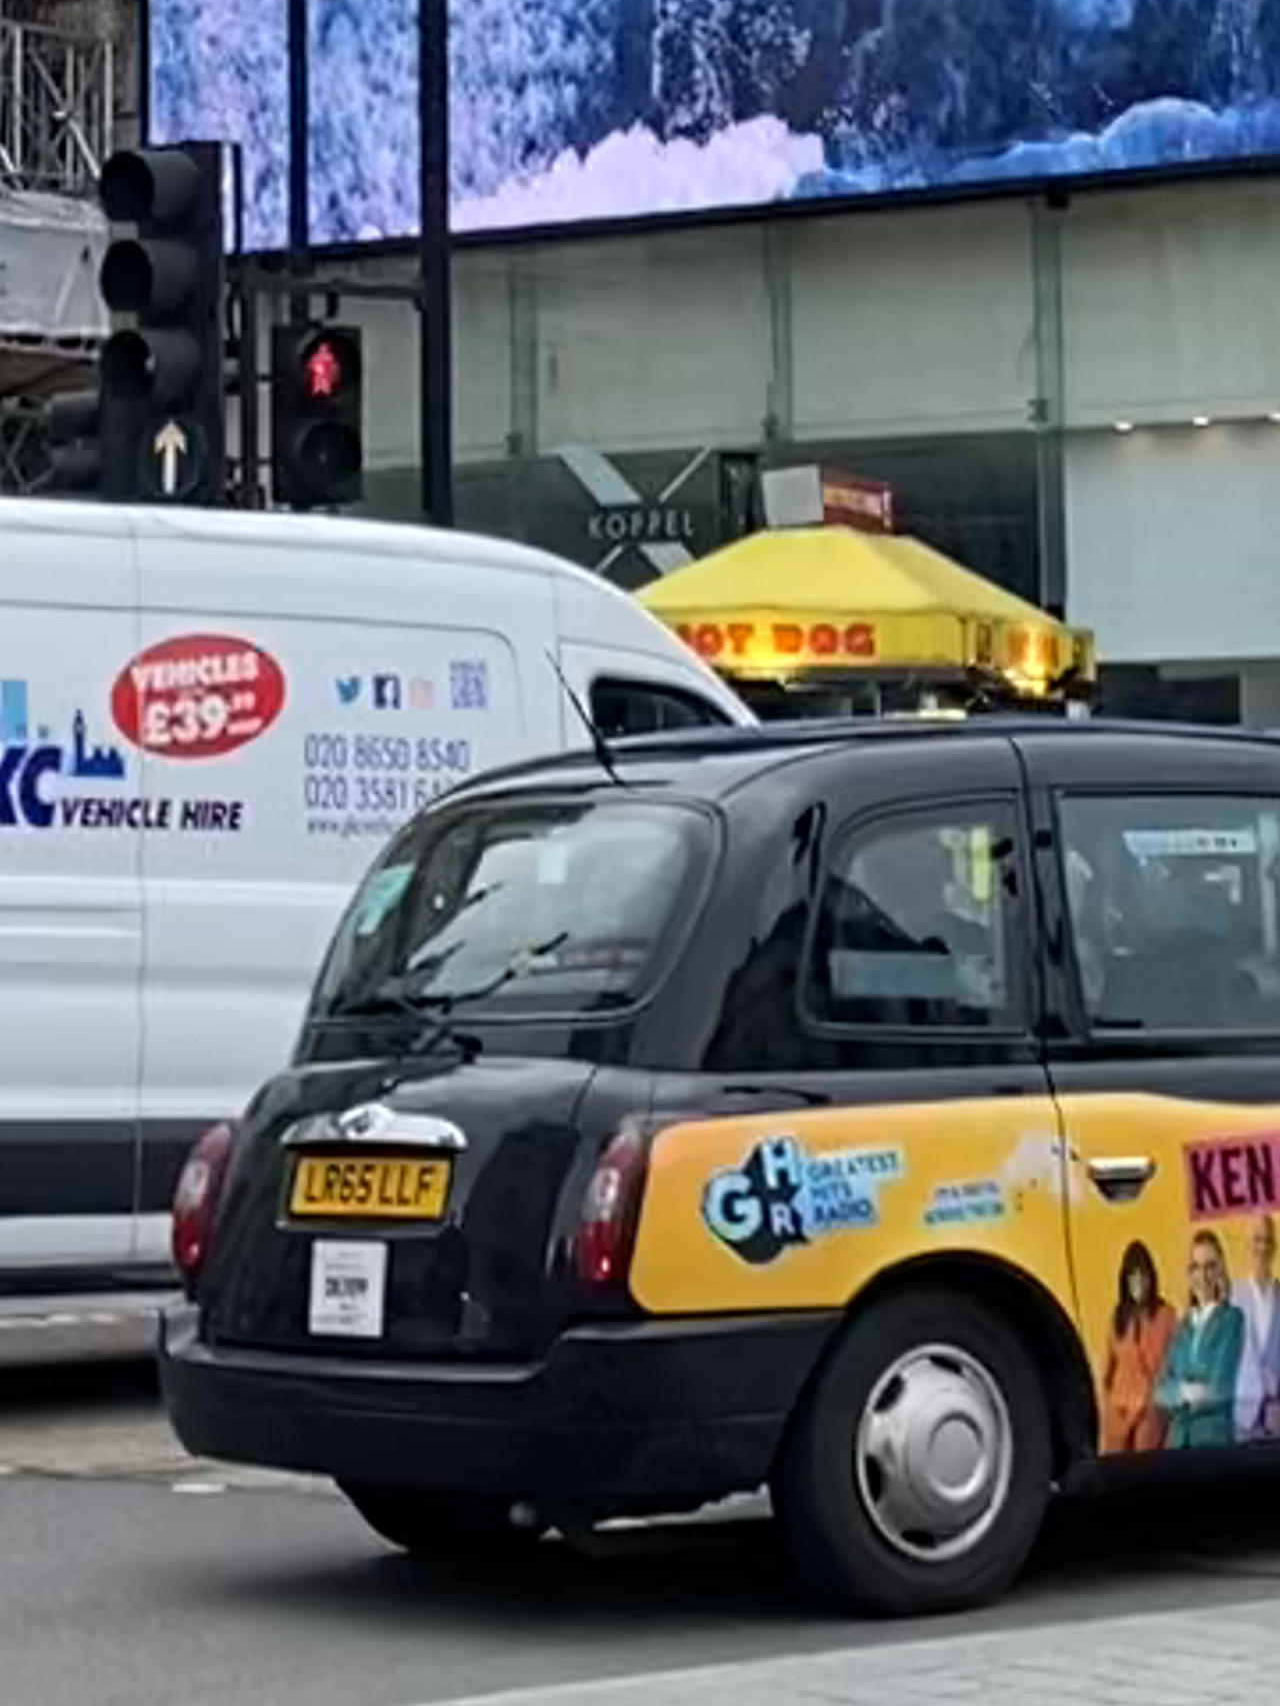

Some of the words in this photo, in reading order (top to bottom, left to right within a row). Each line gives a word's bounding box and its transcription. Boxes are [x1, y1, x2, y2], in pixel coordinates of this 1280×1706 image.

[587, 507, 695, 540] KOPPEL
[772, 622, 877, 656] DOG
[130, 652, 259, 691] VEHICLES
[303, 734, 348, 769] 020
[61, 797, 173, 829] VEHICLE
[179, 799, 244, 832] HIRE
[304, 1164, 375, 1205] LR65
[378, 1164, 436, 1206] LLF
[807, 1152, 898, 1184] GREATEST
[1189, 1143, 1276, 1212] KEN
[812, 1198, 874, 1225] RADIO
